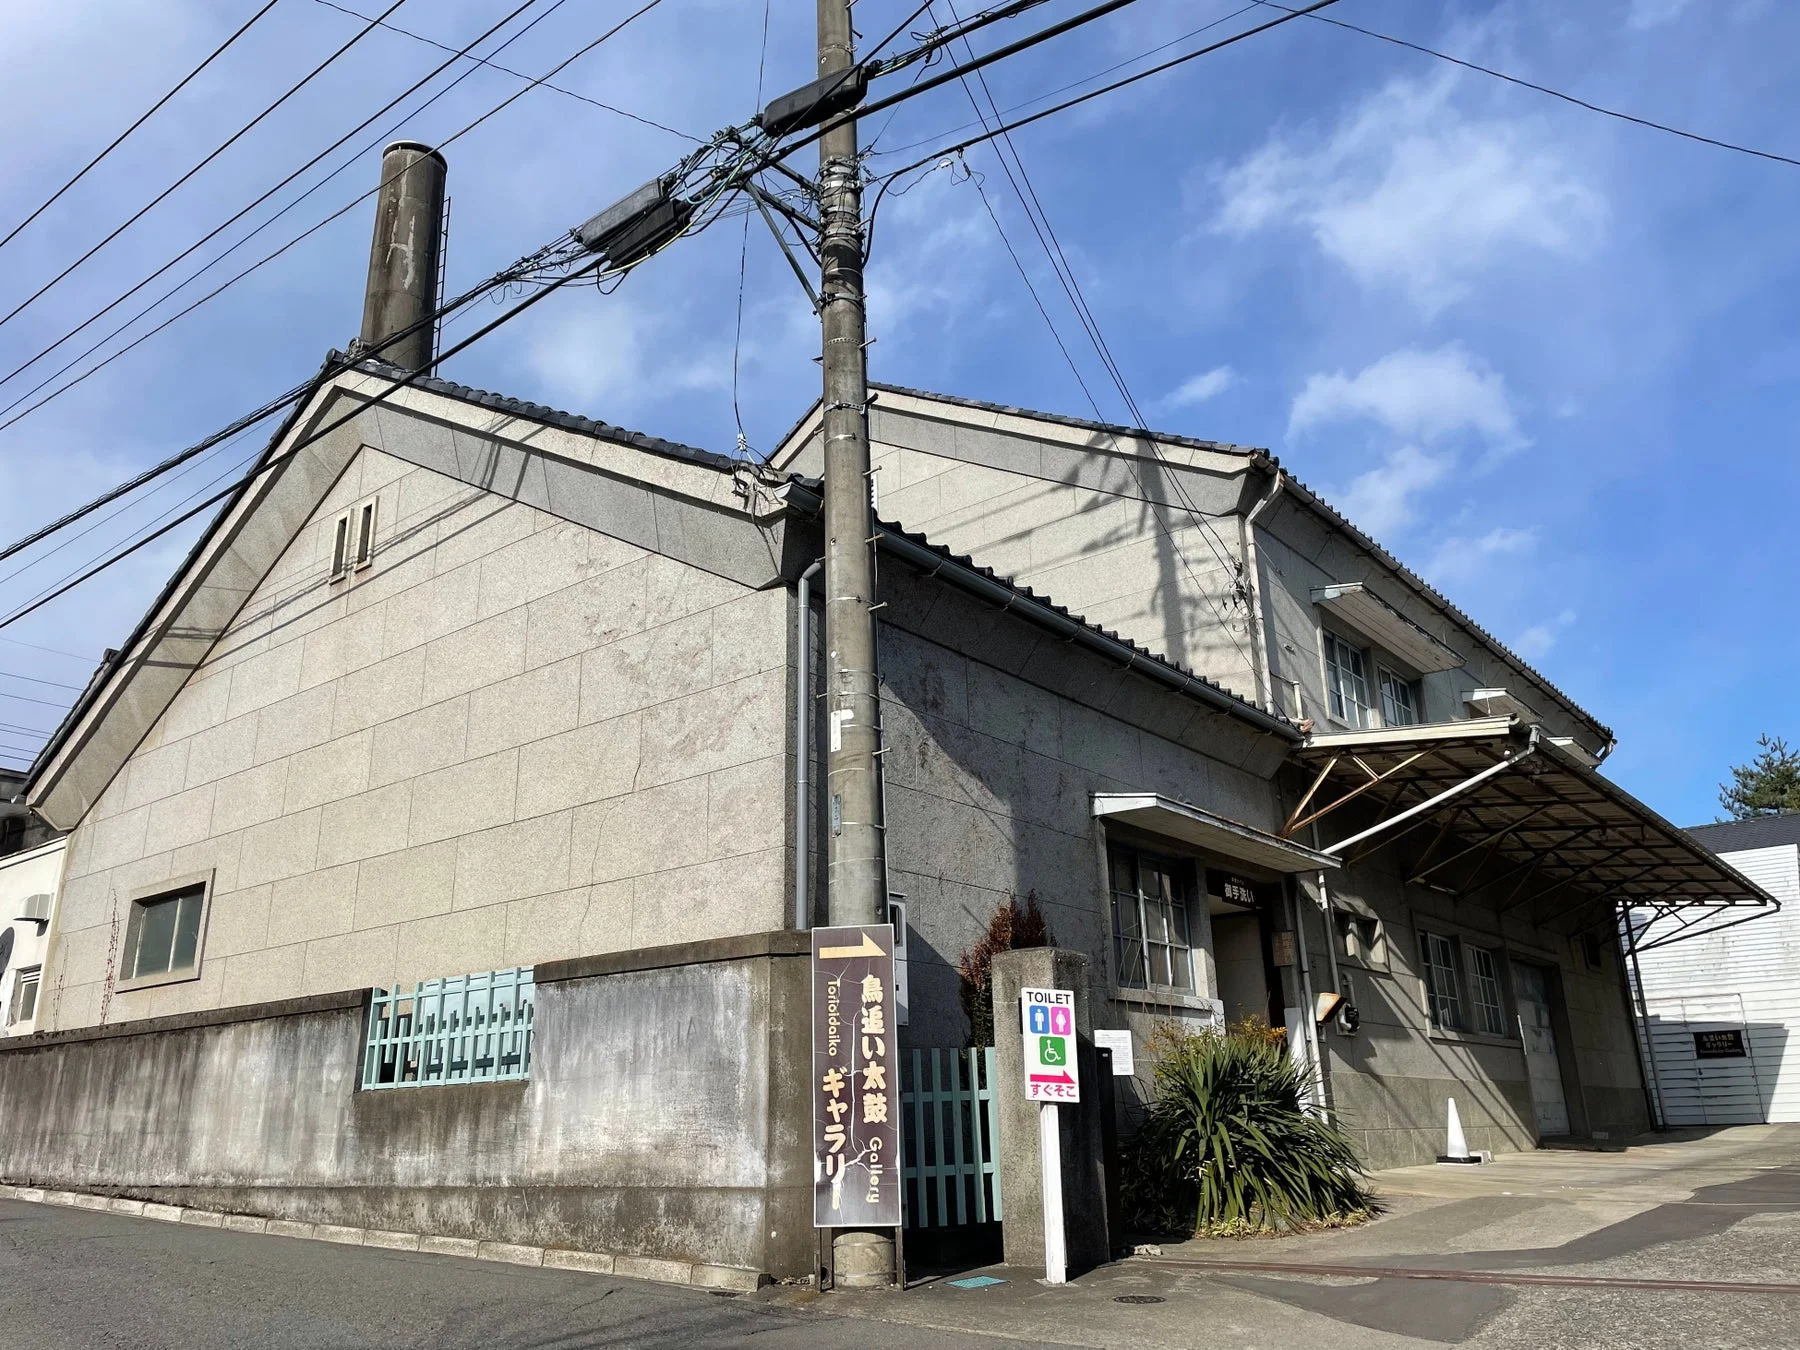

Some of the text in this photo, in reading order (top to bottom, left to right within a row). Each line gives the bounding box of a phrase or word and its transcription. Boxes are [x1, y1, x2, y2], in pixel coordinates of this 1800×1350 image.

[1026, 991, 1071, 1005] TOILET
[822, 980, 849, 1210] Torioidaiko ギャラリー
[861, 974, 888, 1203] 鳥追い太鼓 Gallery
[1030, 1083, 1076, 1098] すぐそこ
